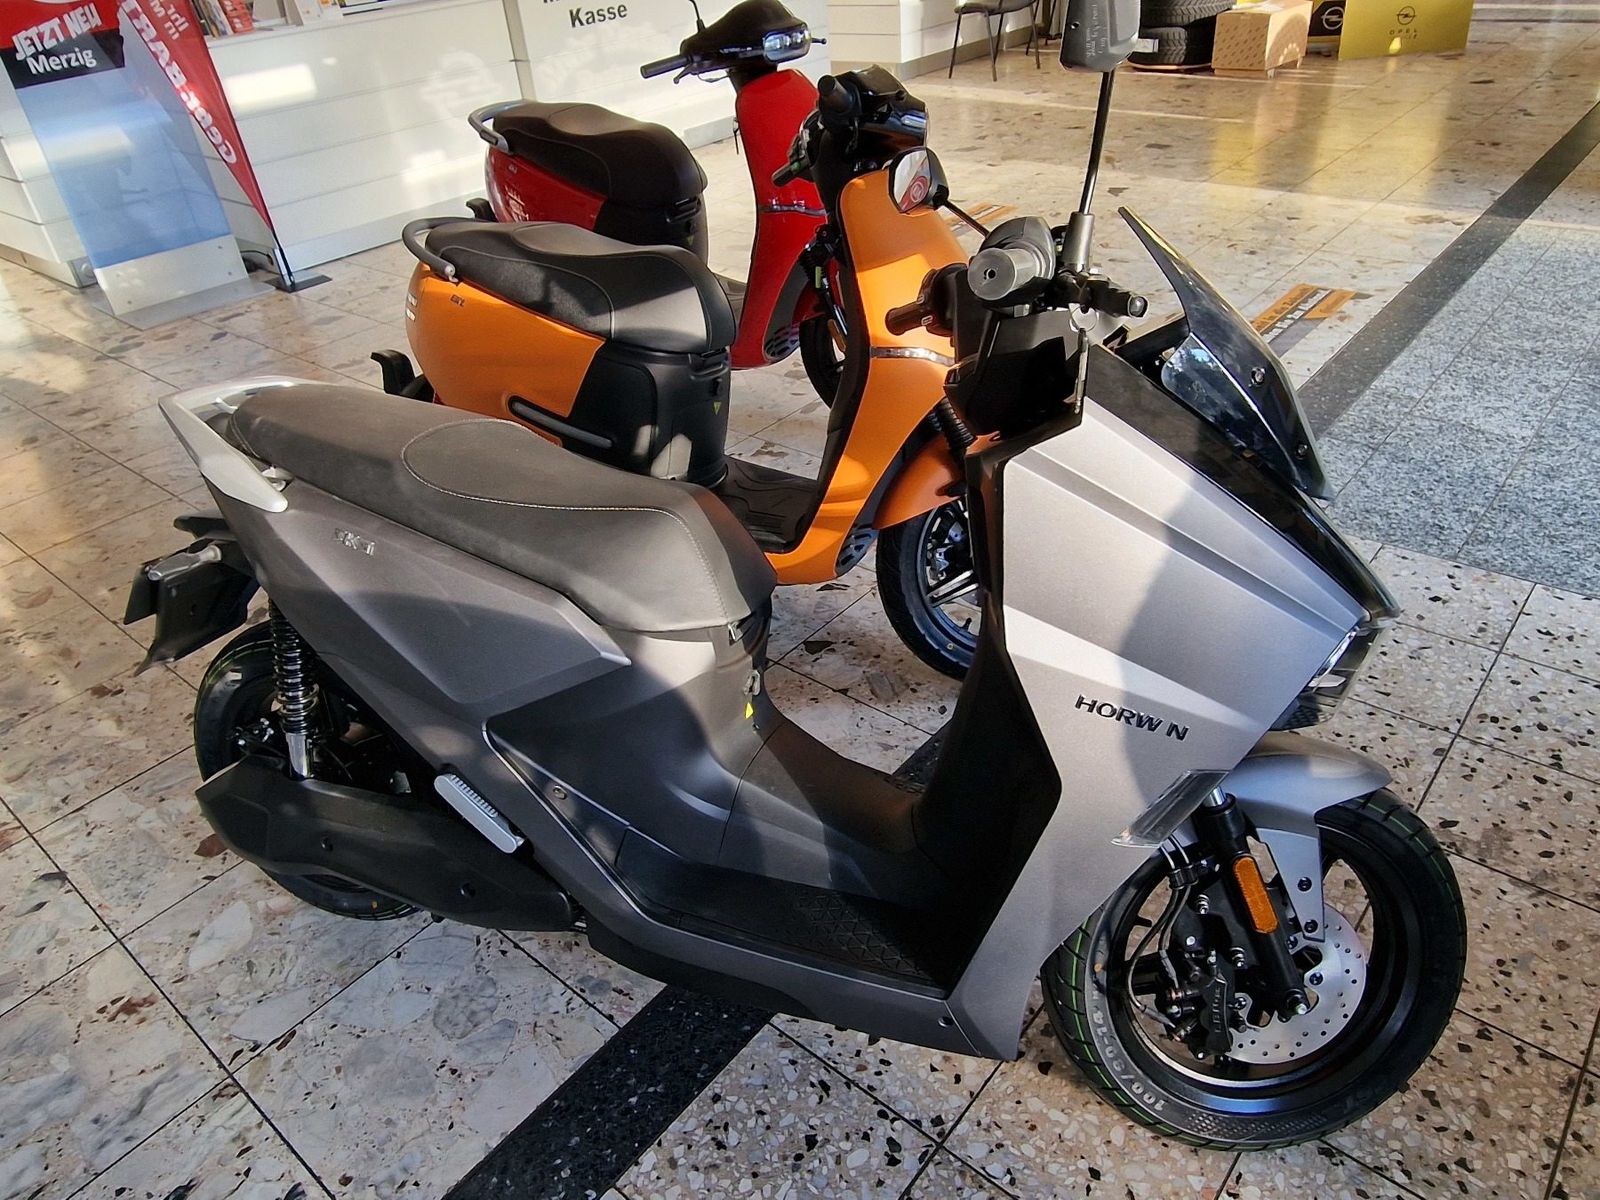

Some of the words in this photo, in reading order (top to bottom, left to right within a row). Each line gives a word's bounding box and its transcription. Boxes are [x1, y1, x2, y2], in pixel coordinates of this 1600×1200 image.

[12, 17, 65, 60] JETZT
[63, 3, 102, 39] NEU
[569, 4, 628, 28] Kasse
[26, 47, 97, 75] Merzig
[1074, 694, 1190, 741] HORWN
